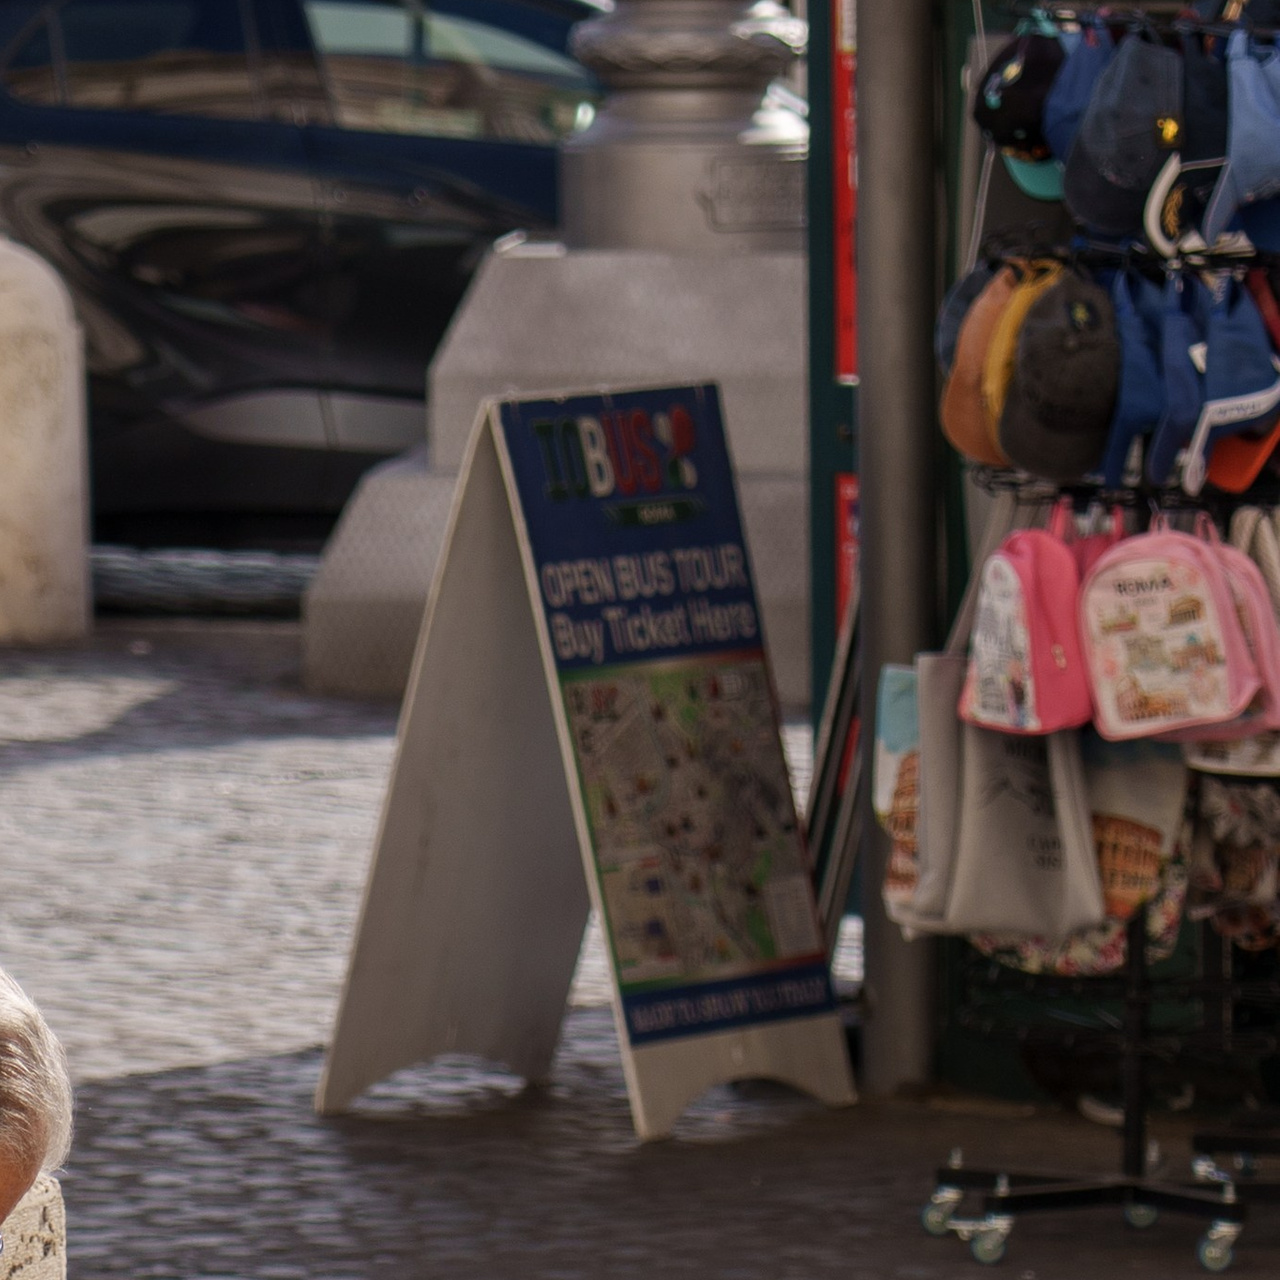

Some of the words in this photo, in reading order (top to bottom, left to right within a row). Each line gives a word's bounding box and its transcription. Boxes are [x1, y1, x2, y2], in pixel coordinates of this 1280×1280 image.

[542, 557, 616, 608] OPEN
[613, 550, 675, 601] BUS
[674, 543, 747, 593] TOUR
[551, 612, 604, 665] Buy
[602, 603, 691, 653] Ticket
[687, 596, 756, 644] Here
